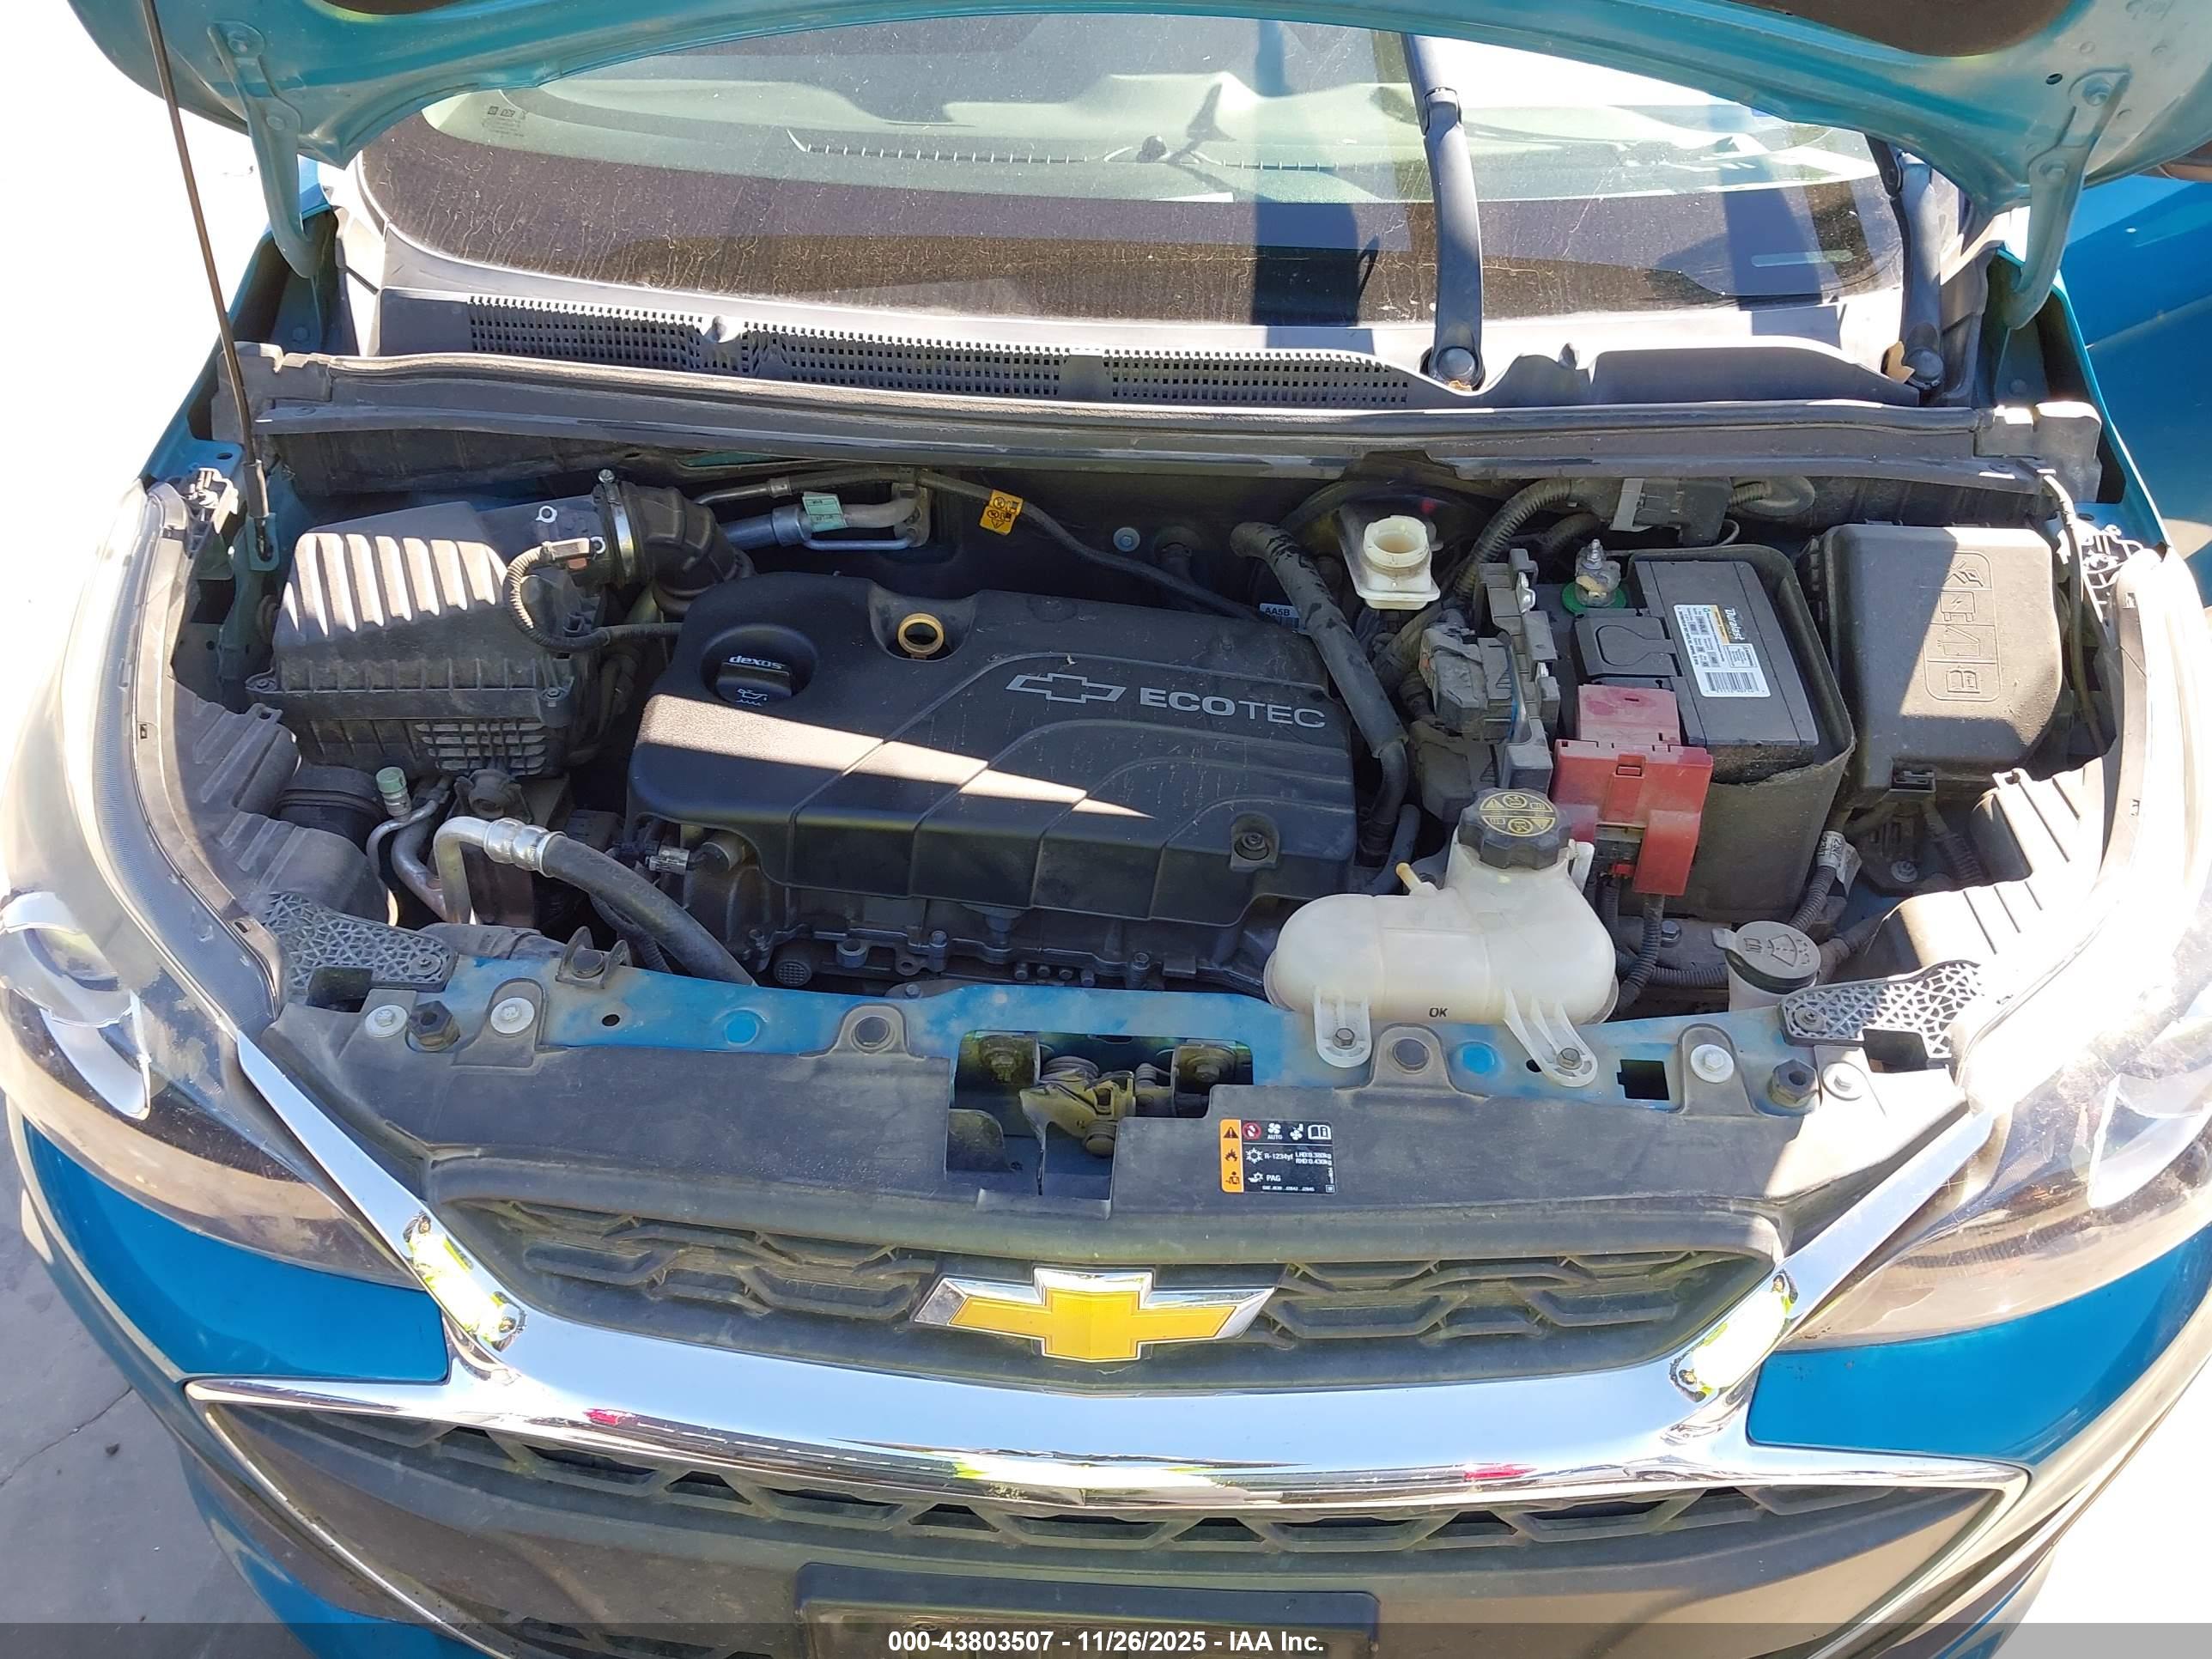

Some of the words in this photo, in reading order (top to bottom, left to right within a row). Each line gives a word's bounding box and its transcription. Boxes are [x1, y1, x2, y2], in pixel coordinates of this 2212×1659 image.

[1723, 607, 1746, 641] Duralast
[728, 655, 783, 670] dexos
[1139, 686, 1327, 729] ECOTEC
[1429, 1007, 1449, 1018] OK
